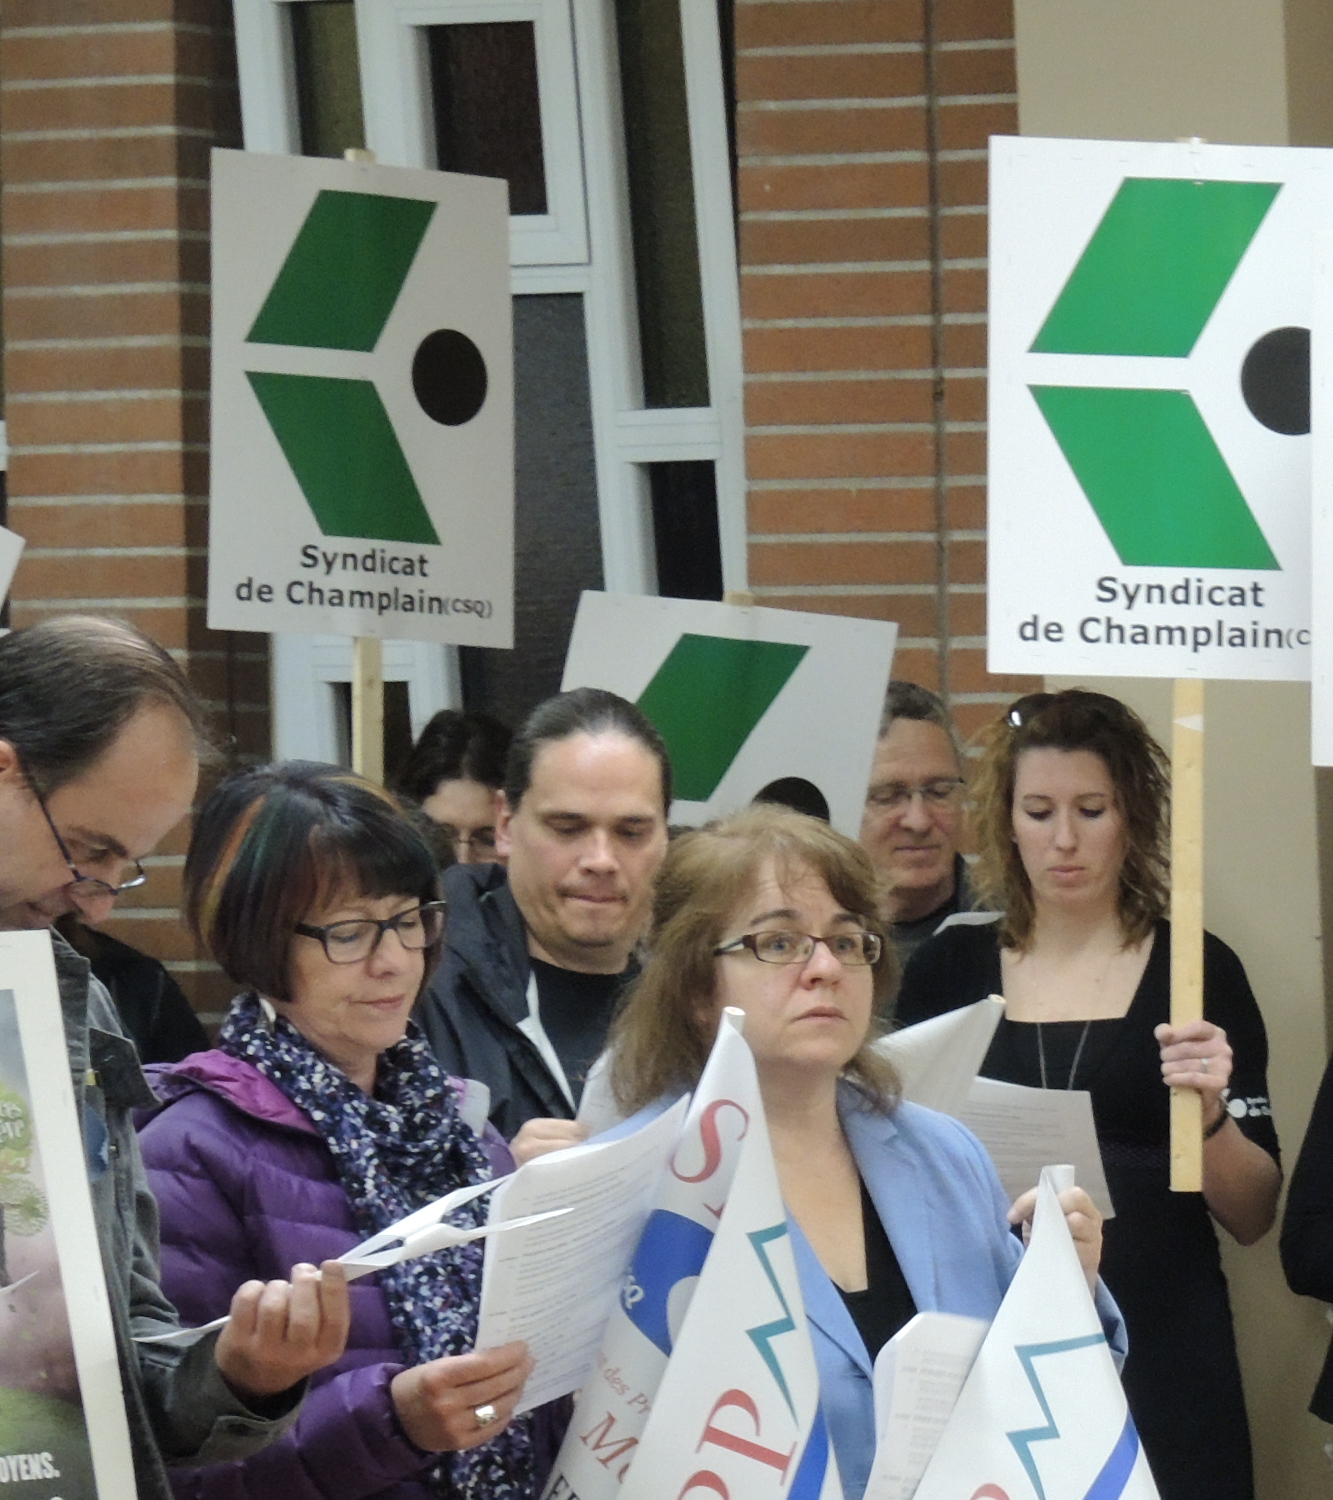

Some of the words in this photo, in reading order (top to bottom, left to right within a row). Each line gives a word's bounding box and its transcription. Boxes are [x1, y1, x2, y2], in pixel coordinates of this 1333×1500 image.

[301, 544, 429, 577] Syndicat
[236, 577, 274, 602] de
[1096, 576, 1265, 609] Syndicat
[1019, 615, 1065, 642] de
